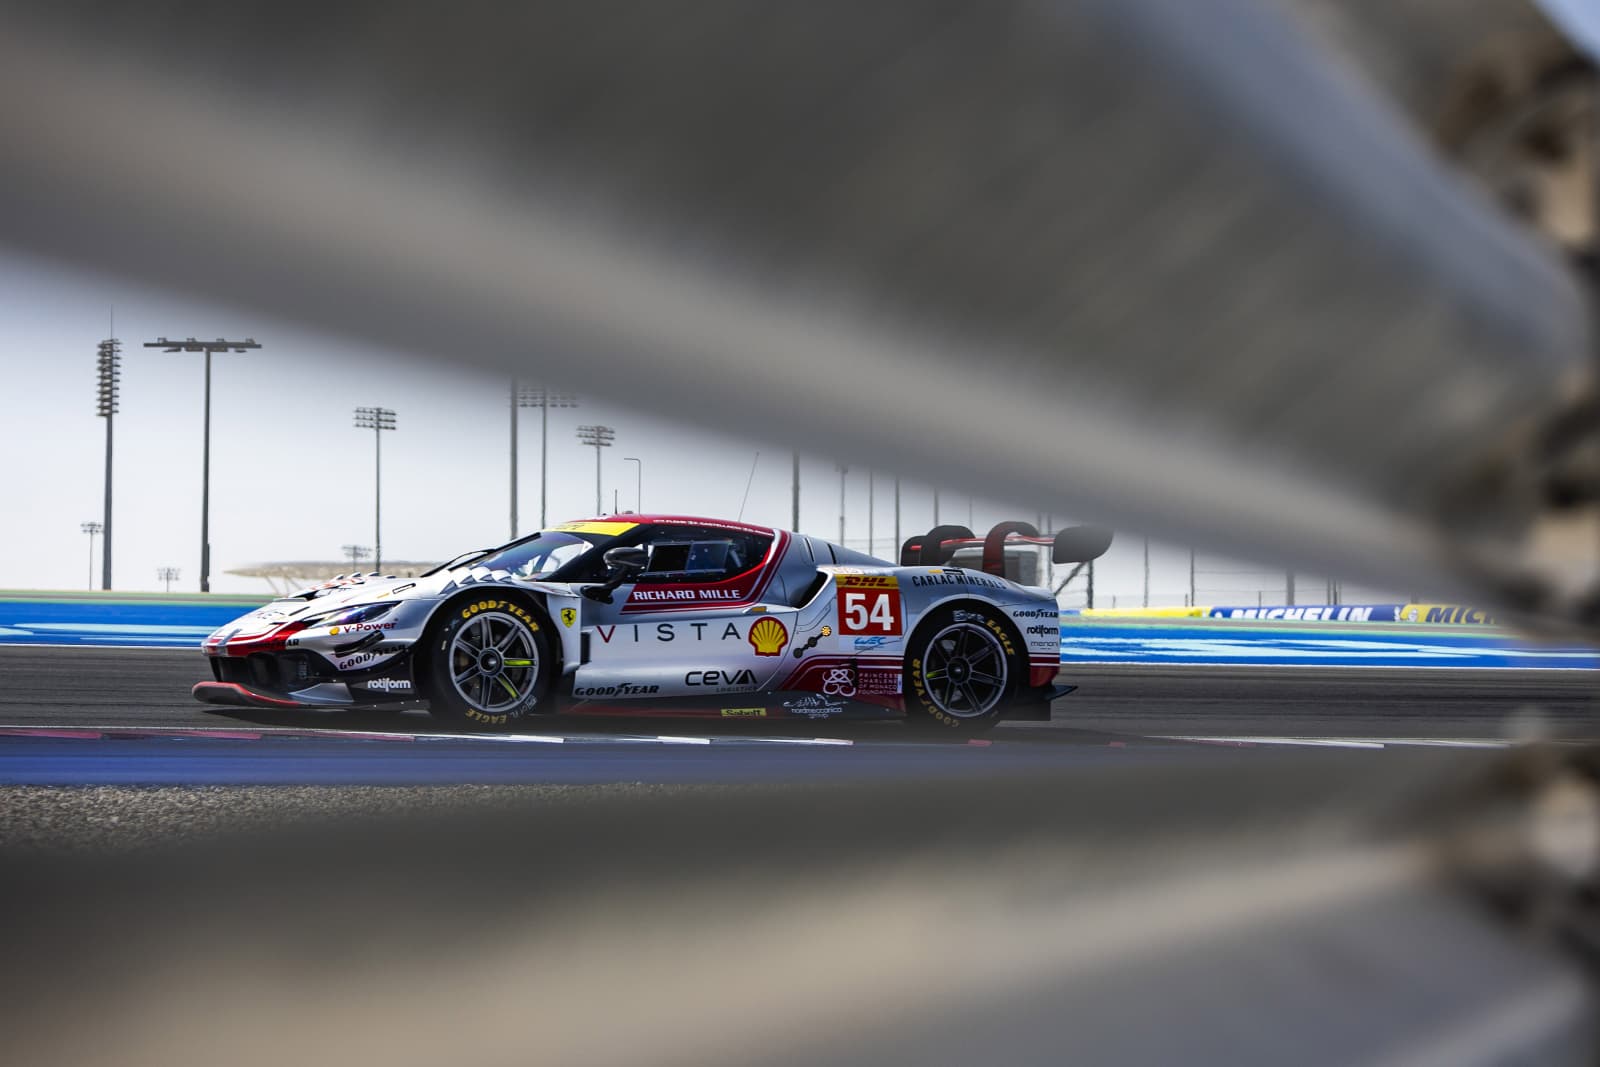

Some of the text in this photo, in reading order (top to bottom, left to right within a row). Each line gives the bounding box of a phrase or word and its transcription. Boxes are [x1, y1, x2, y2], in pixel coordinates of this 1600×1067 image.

[844, 576, 890, 587] DHL
[911, 574, 1008, 590] CARLAC MINERALS
[632, 589, 741, 600] RICHARD MILLE
[461, 600, 540, 632] GOODYEAR
[845, 592, 895, 631] 54
[1012, 608, 1059, 620] GOODYEAR
[1229, 607, 1373, 621] MICHELIN
[343, 621, 397, 633] V-Power
[596, 622, 742, 644] VISTA
[1026, 624, 1059, 638] rotiform
[986, 619, 1016, 656] EAGLE
[338, 644, 407, 670] GOODYEAR
[367, 677, 411, 692] rotiform
[574, 682, 660, 697] GOODYEAR
[465, 708, 507, 724] EAGLE
